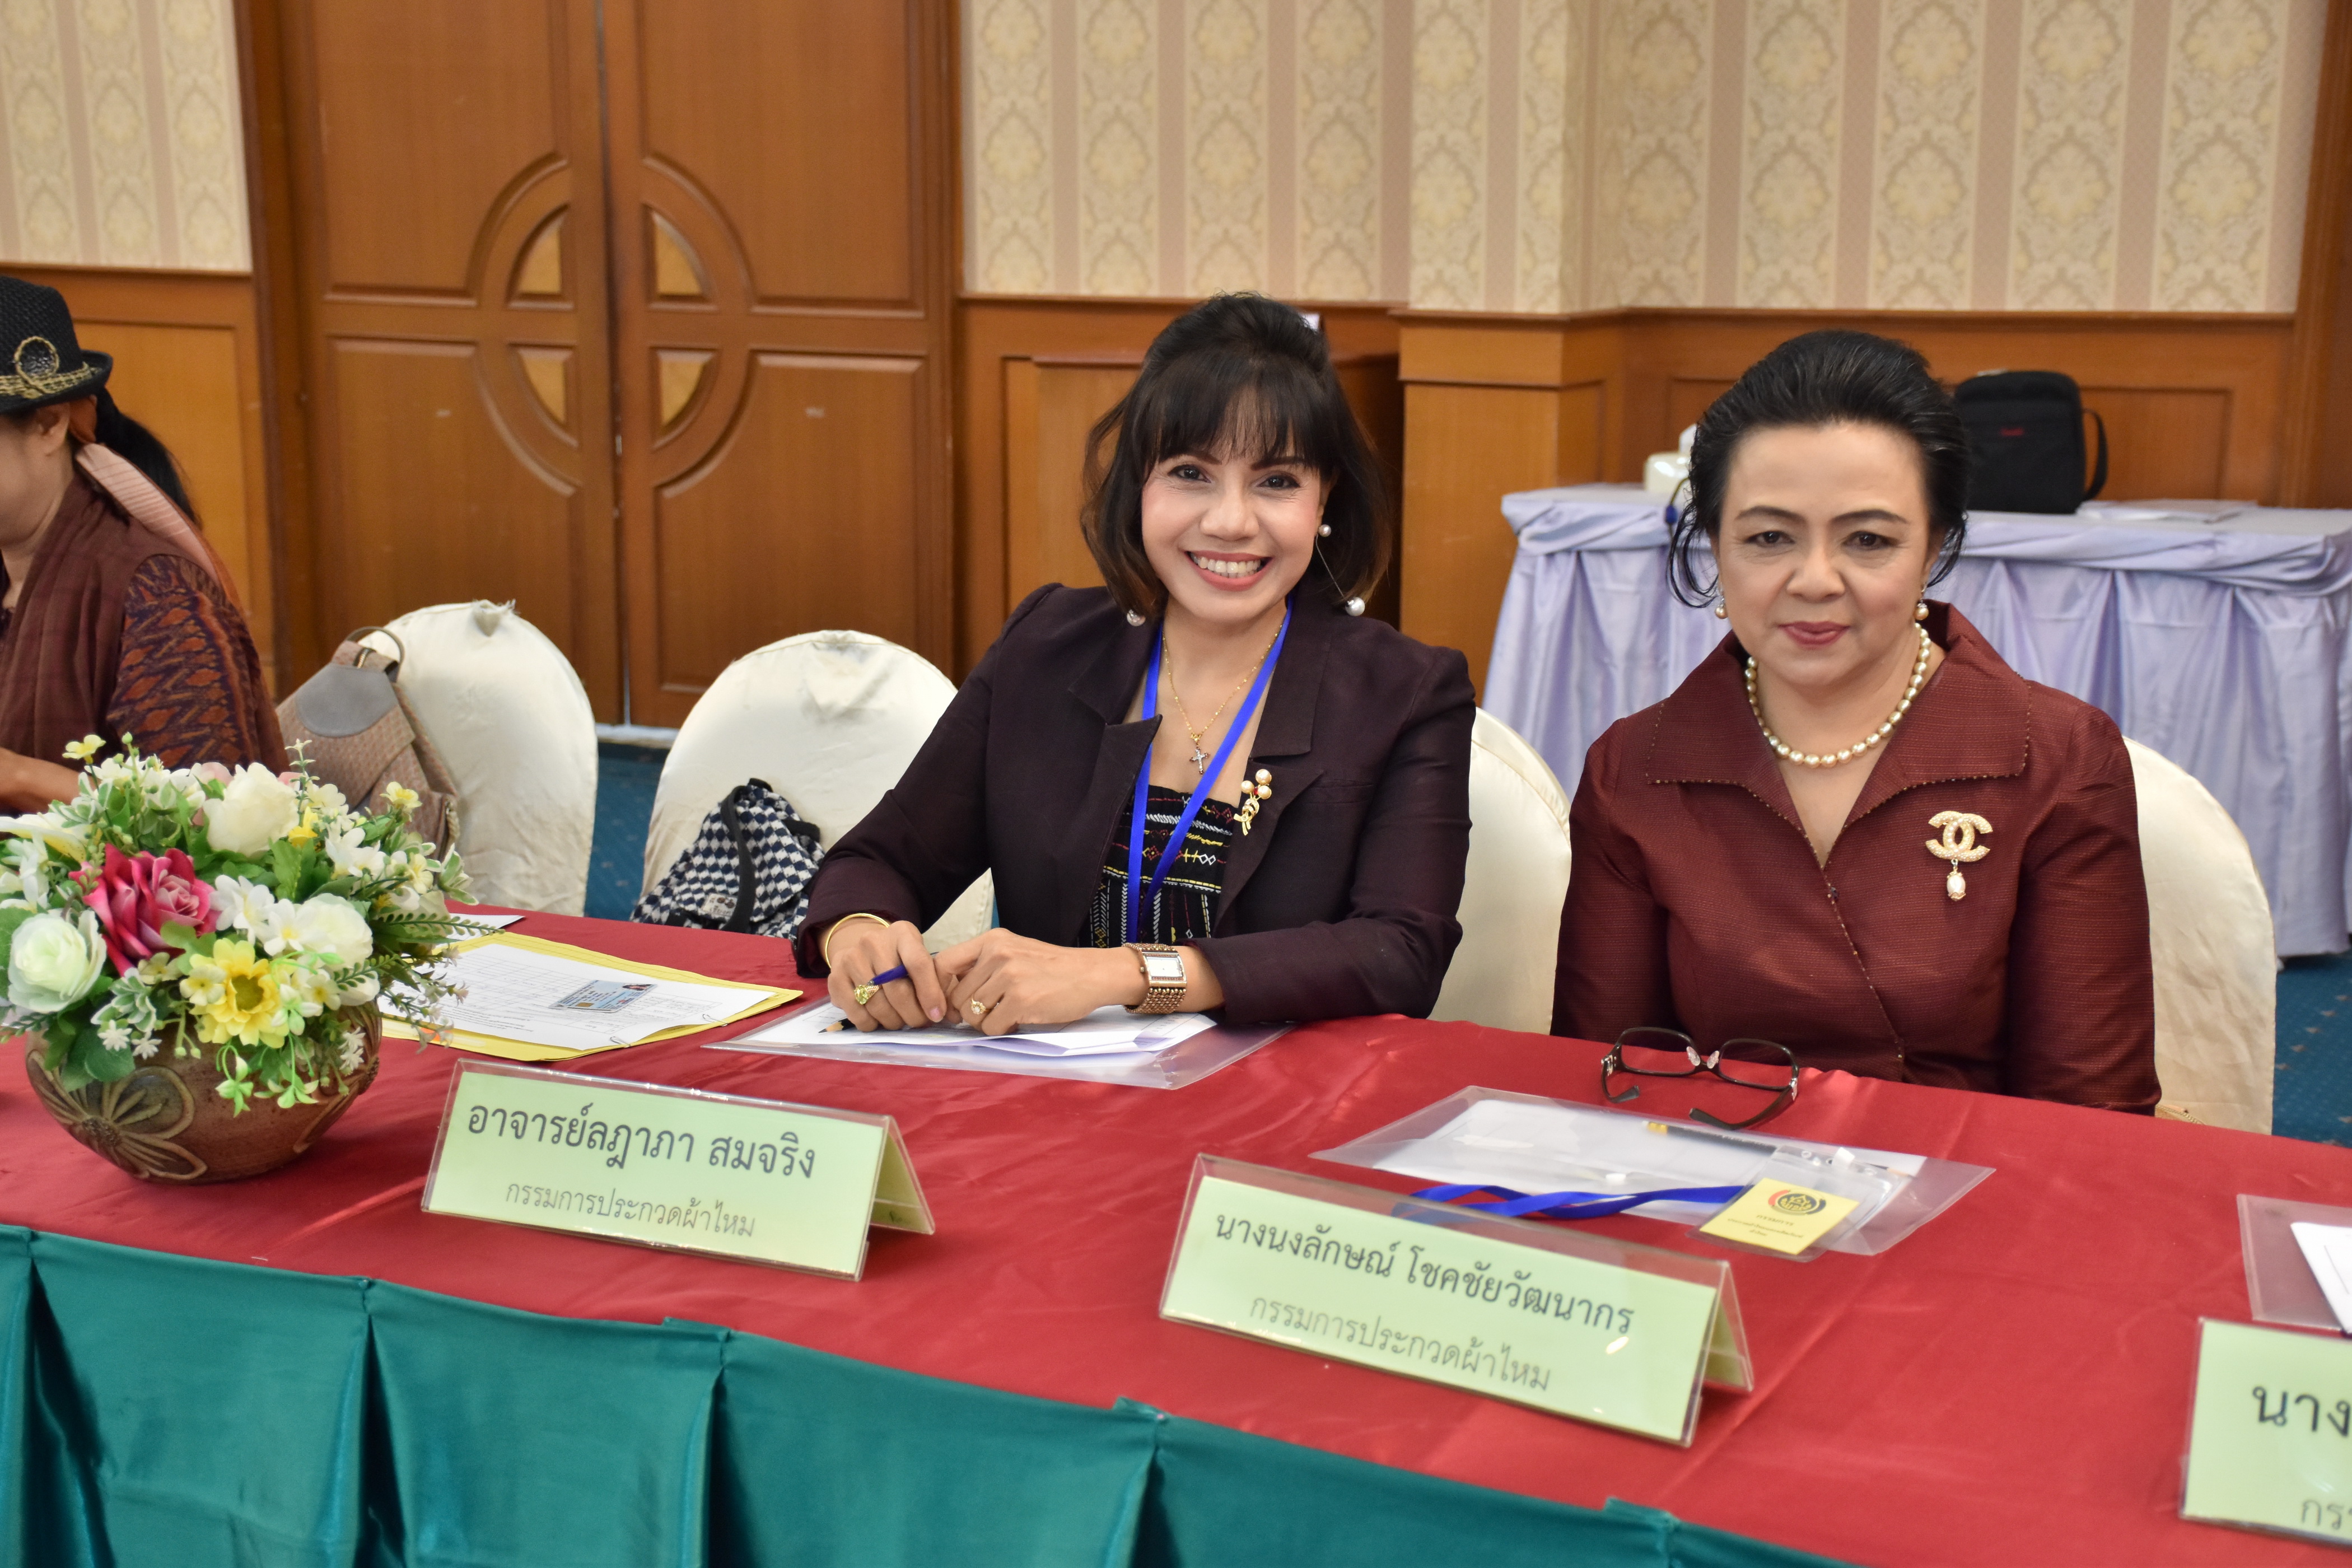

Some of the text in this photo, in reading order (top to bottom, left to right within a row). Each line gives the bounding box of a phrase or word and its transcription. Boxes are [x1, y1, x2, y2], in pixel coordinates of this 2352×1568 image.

[468, 1102, 816, 1178] อาจารย์ลฎาภา สมจริง
[506, 1183, 756, 1237] กรรมการประกวดผ้าไหม
[1216, 1213, 1635, 1334] นางนงลักษณ์ โชคชัยวัฒนากร
[1250, 1296, 1551, 1392] กรรมการประกวดผ้าไหม
[2300, 1499, 2352, 1530] กร
